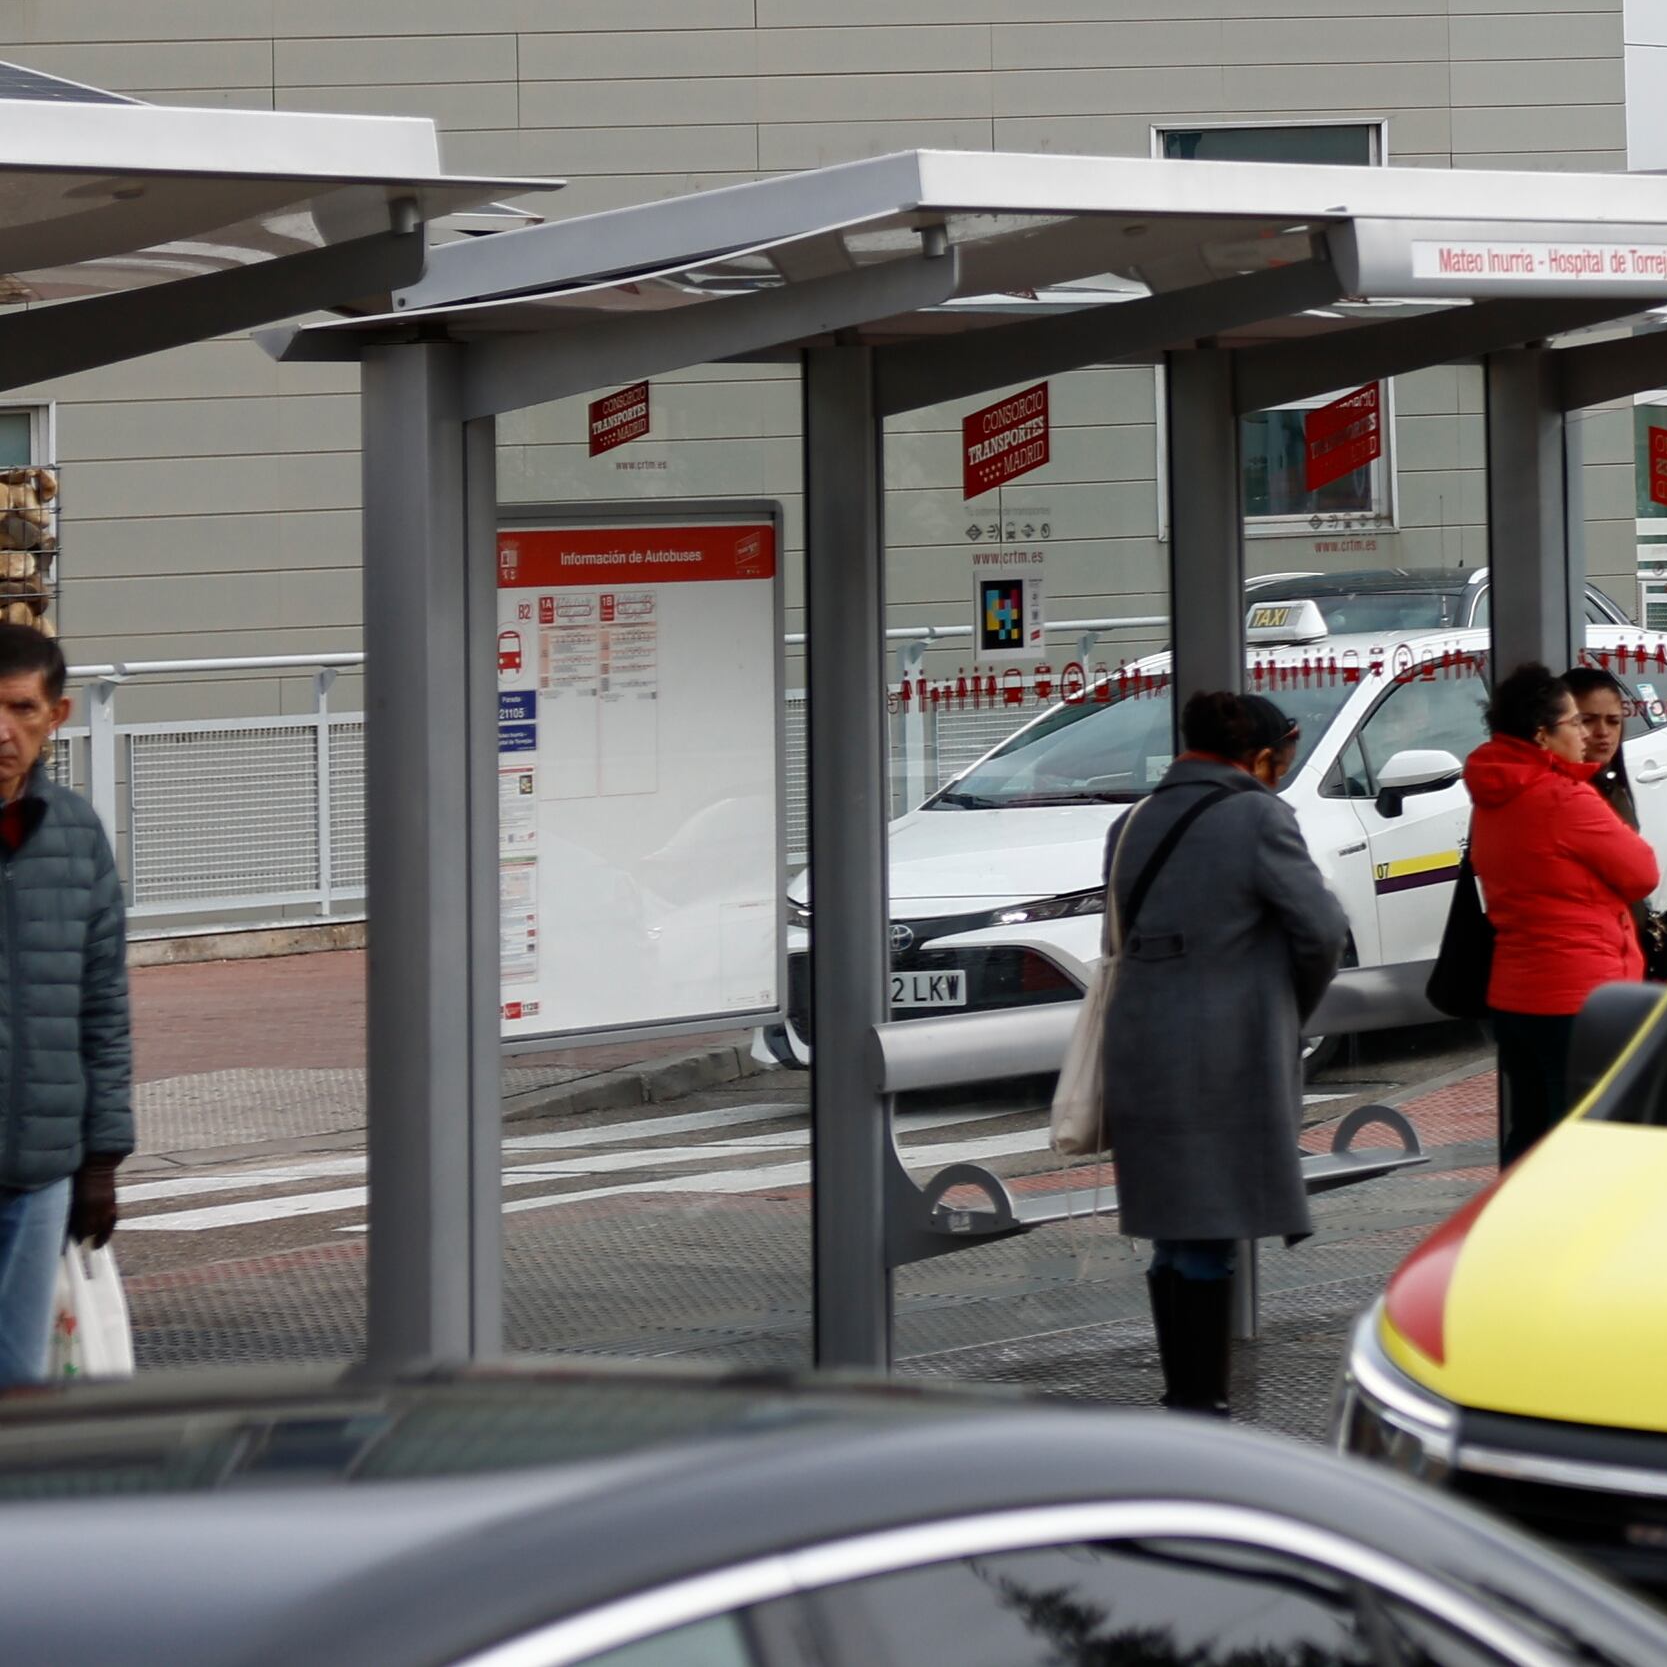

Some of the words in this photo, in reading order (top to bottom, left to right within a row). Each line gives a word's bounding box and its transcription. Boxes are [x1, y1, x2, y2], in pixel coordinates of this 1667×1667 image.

[1438, 247, 1483, 273] Mateo
[1548, 248, 1604, 279] Hospital
[1611, 249, 1627, 273] de
[603, 385, 646, 414] CONSORCIO
[592, 402, 646, 435] TRANSPORTES
[983, 390, 1044, 434] CONSORCIO
[617, 418, 647, 440] MADRID
[968, 415, 1045, 465] TRANSPORTES
[615, 460, 667, 471] www.crtm.es
[1003, 440, 1045, 475] MADRID
[1314, 538, 1377, 553] www.crtm.es
[560, 549, 626, 566] Información
[628, 549, 643, 564] de
[644, 548, 702, 563] Autobuses
[972, 550, 1044, 565] www.crtm.es
[541, 598, 552, 609] 1A
[602, 596, 612, 607] 1B
[1252, 607, 1289, 627] TAXI
[499, 707, 525, 720] 21105
[913, 975, 959, 1002] LKW
